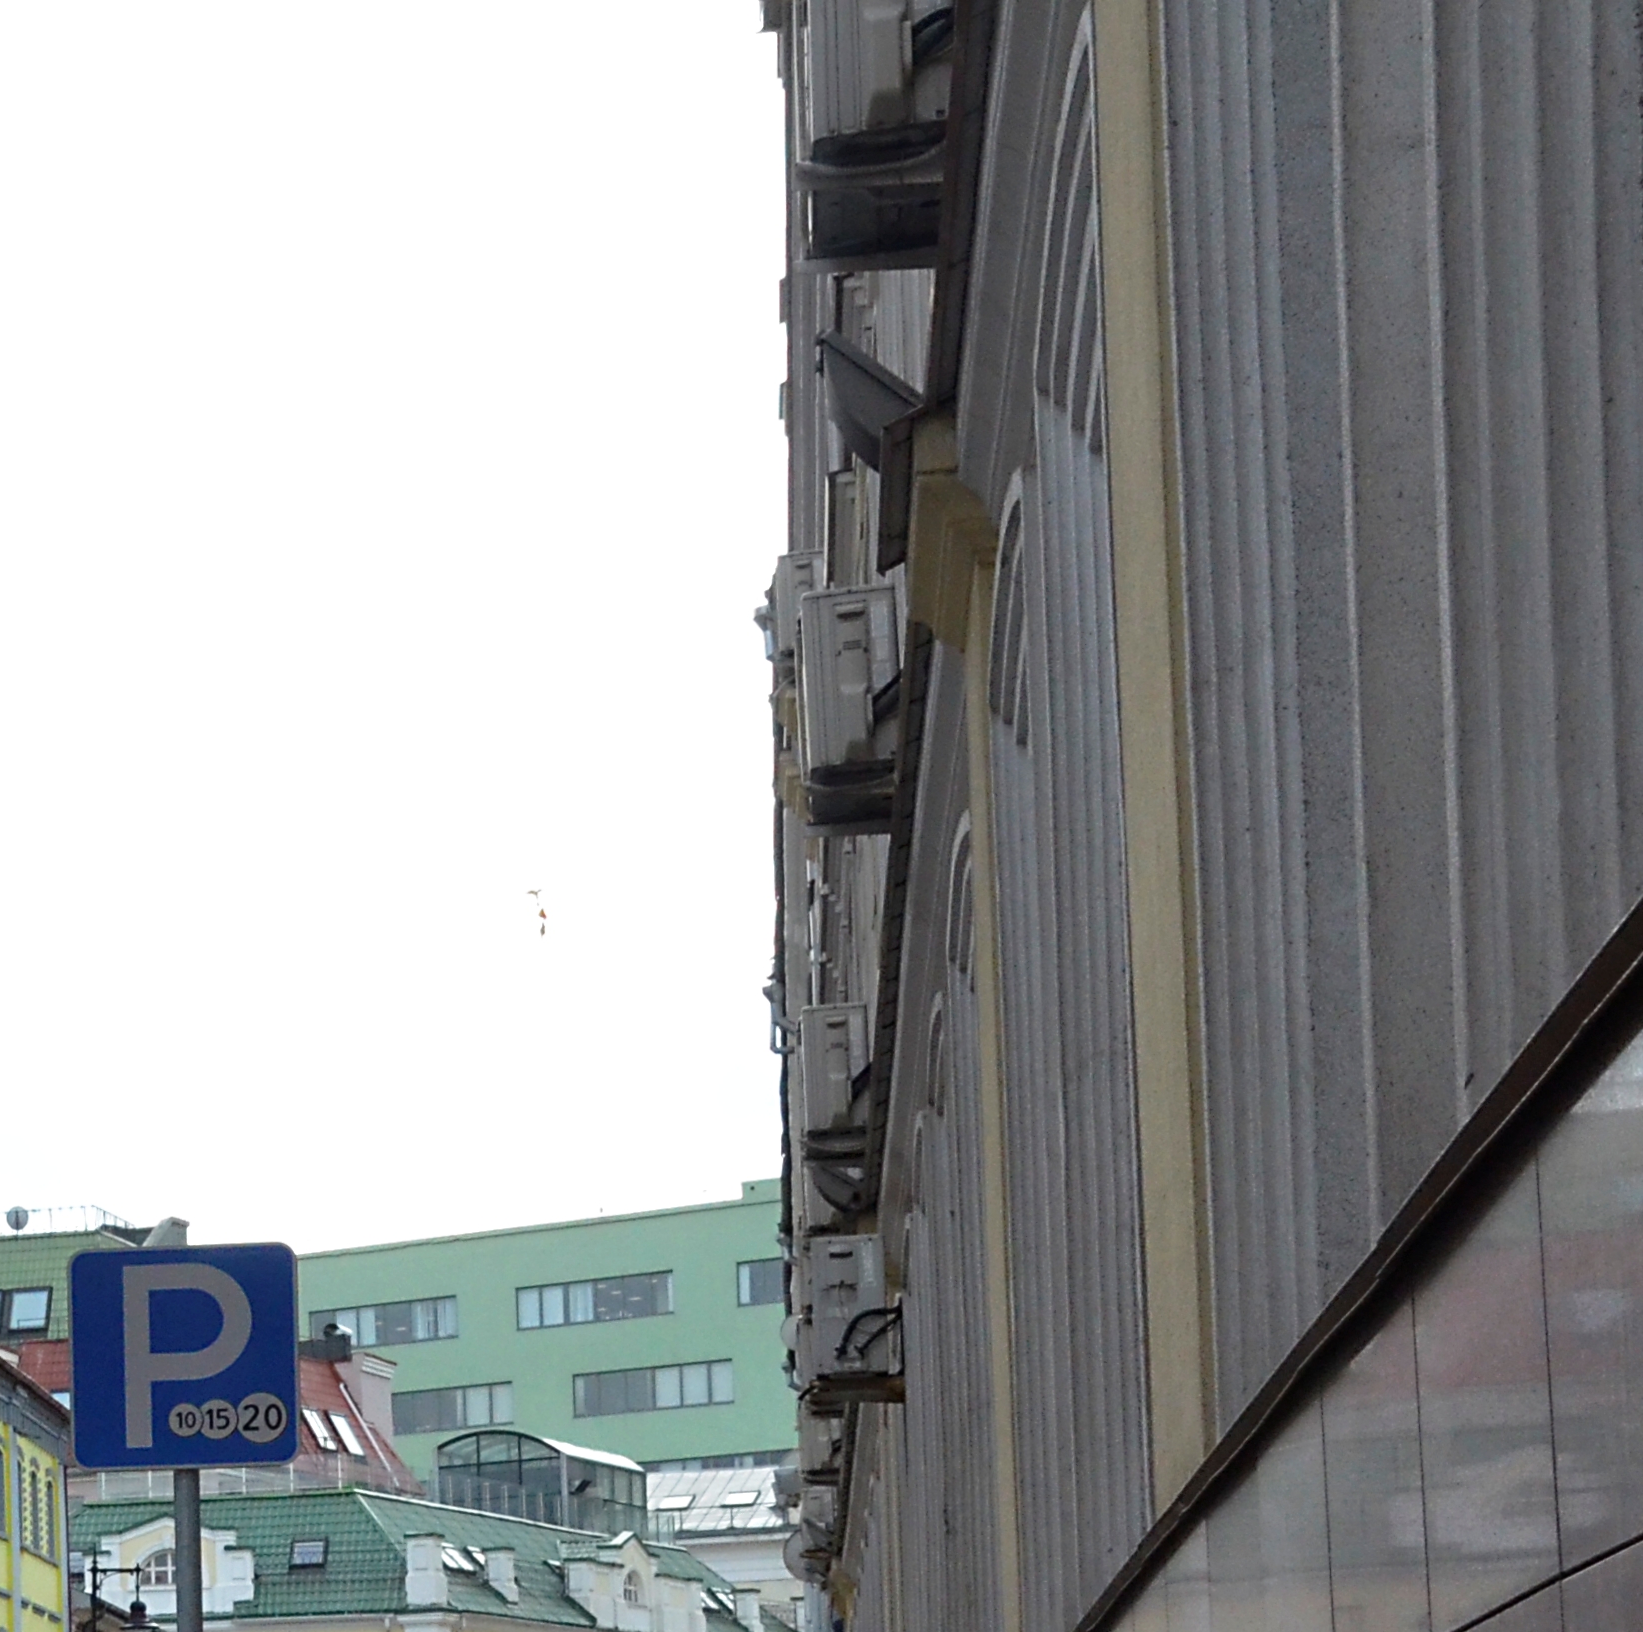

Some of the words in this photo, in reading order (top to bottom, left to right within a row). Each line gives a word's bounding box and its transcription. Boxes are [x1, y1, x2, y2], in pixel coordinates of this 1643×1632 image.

[122, 1262, 253, 1449] P
[175, 1411, 197, 1429] 10
[205, 1408, 231, 1430] 15
[242, 1403, 284, 1432] 20
